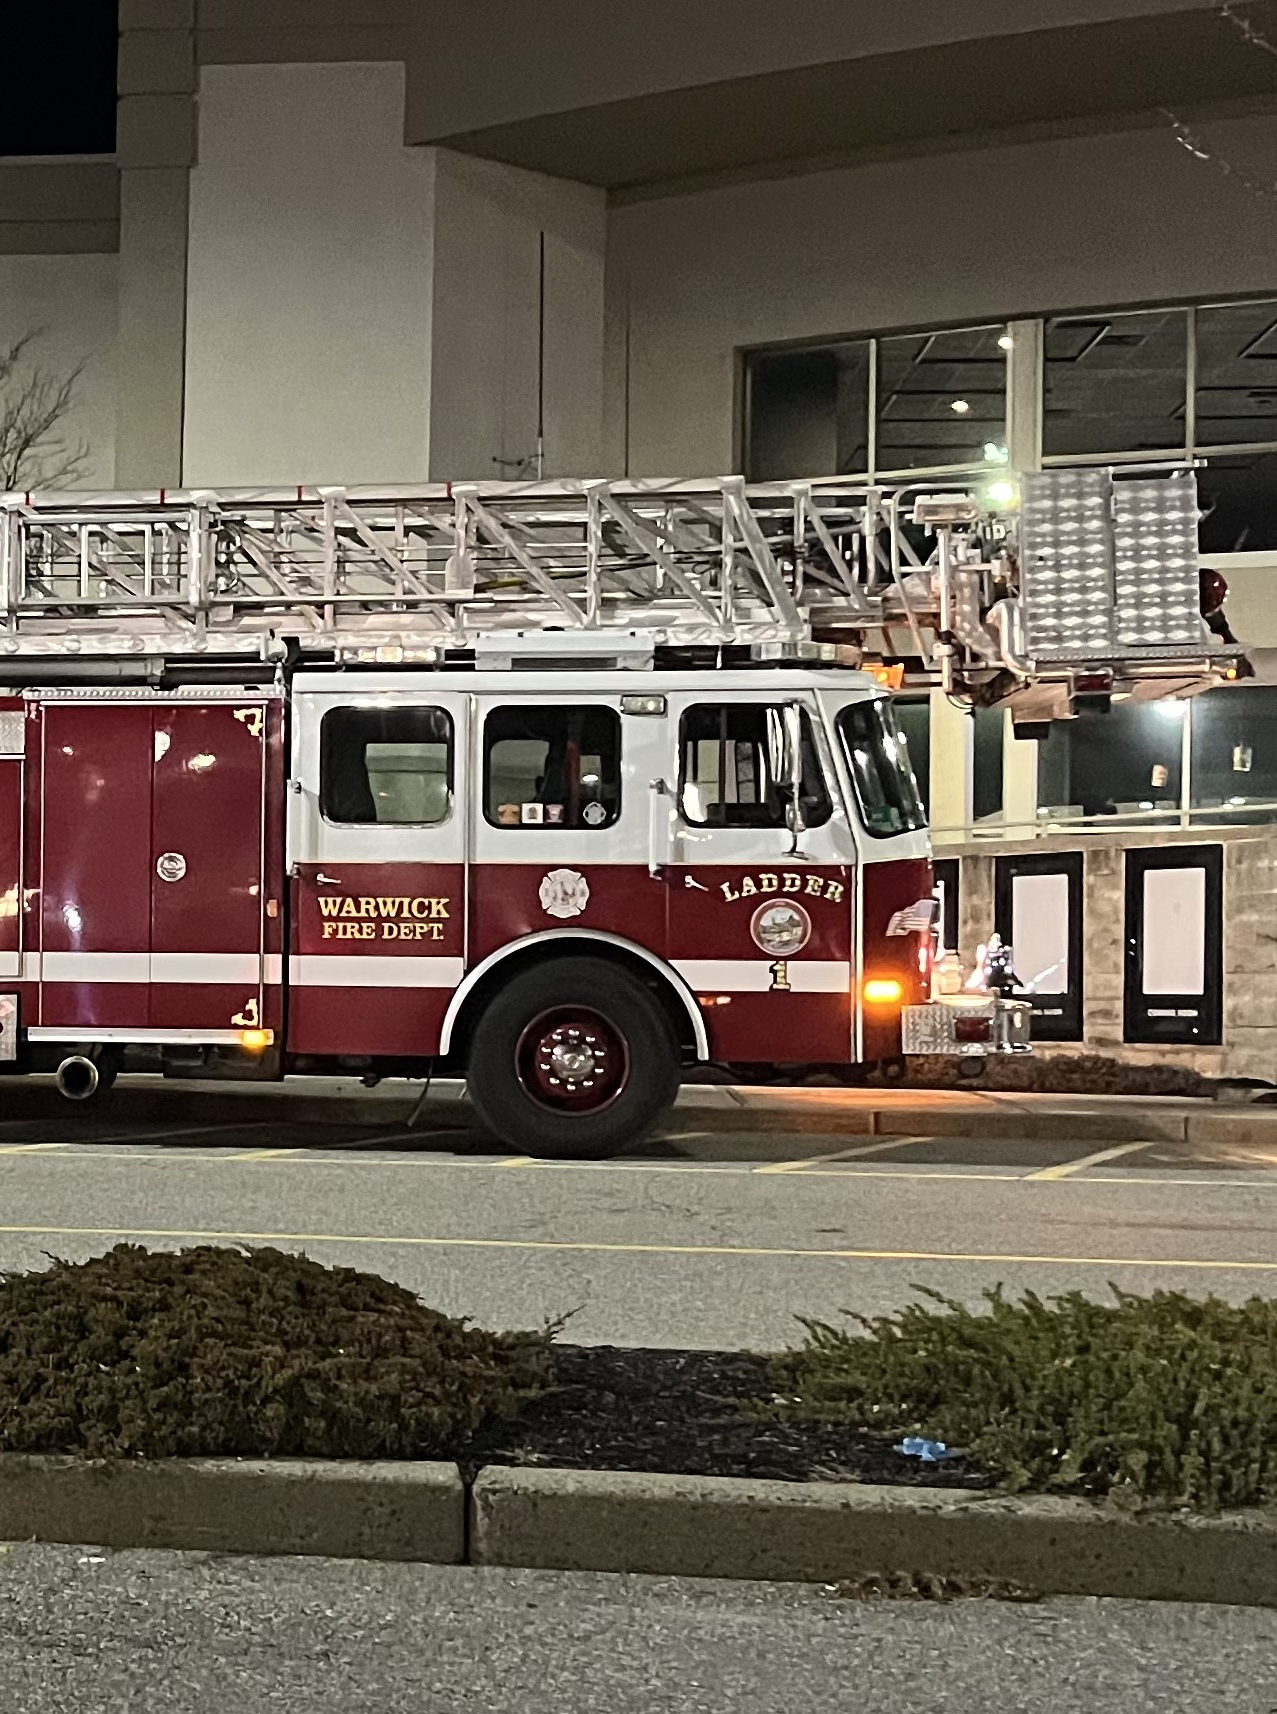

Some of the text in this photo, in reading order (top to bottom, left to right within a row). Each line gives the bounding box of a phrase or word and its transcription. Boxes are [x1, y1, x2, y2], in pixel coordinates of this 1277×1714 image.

[719, 873, 844, 902] LADDER
[317, 897, 450, 918] WARWICK
[322, 922, 444, 940] FIRE DEPT.
[769, 960, 791, 991] 1
